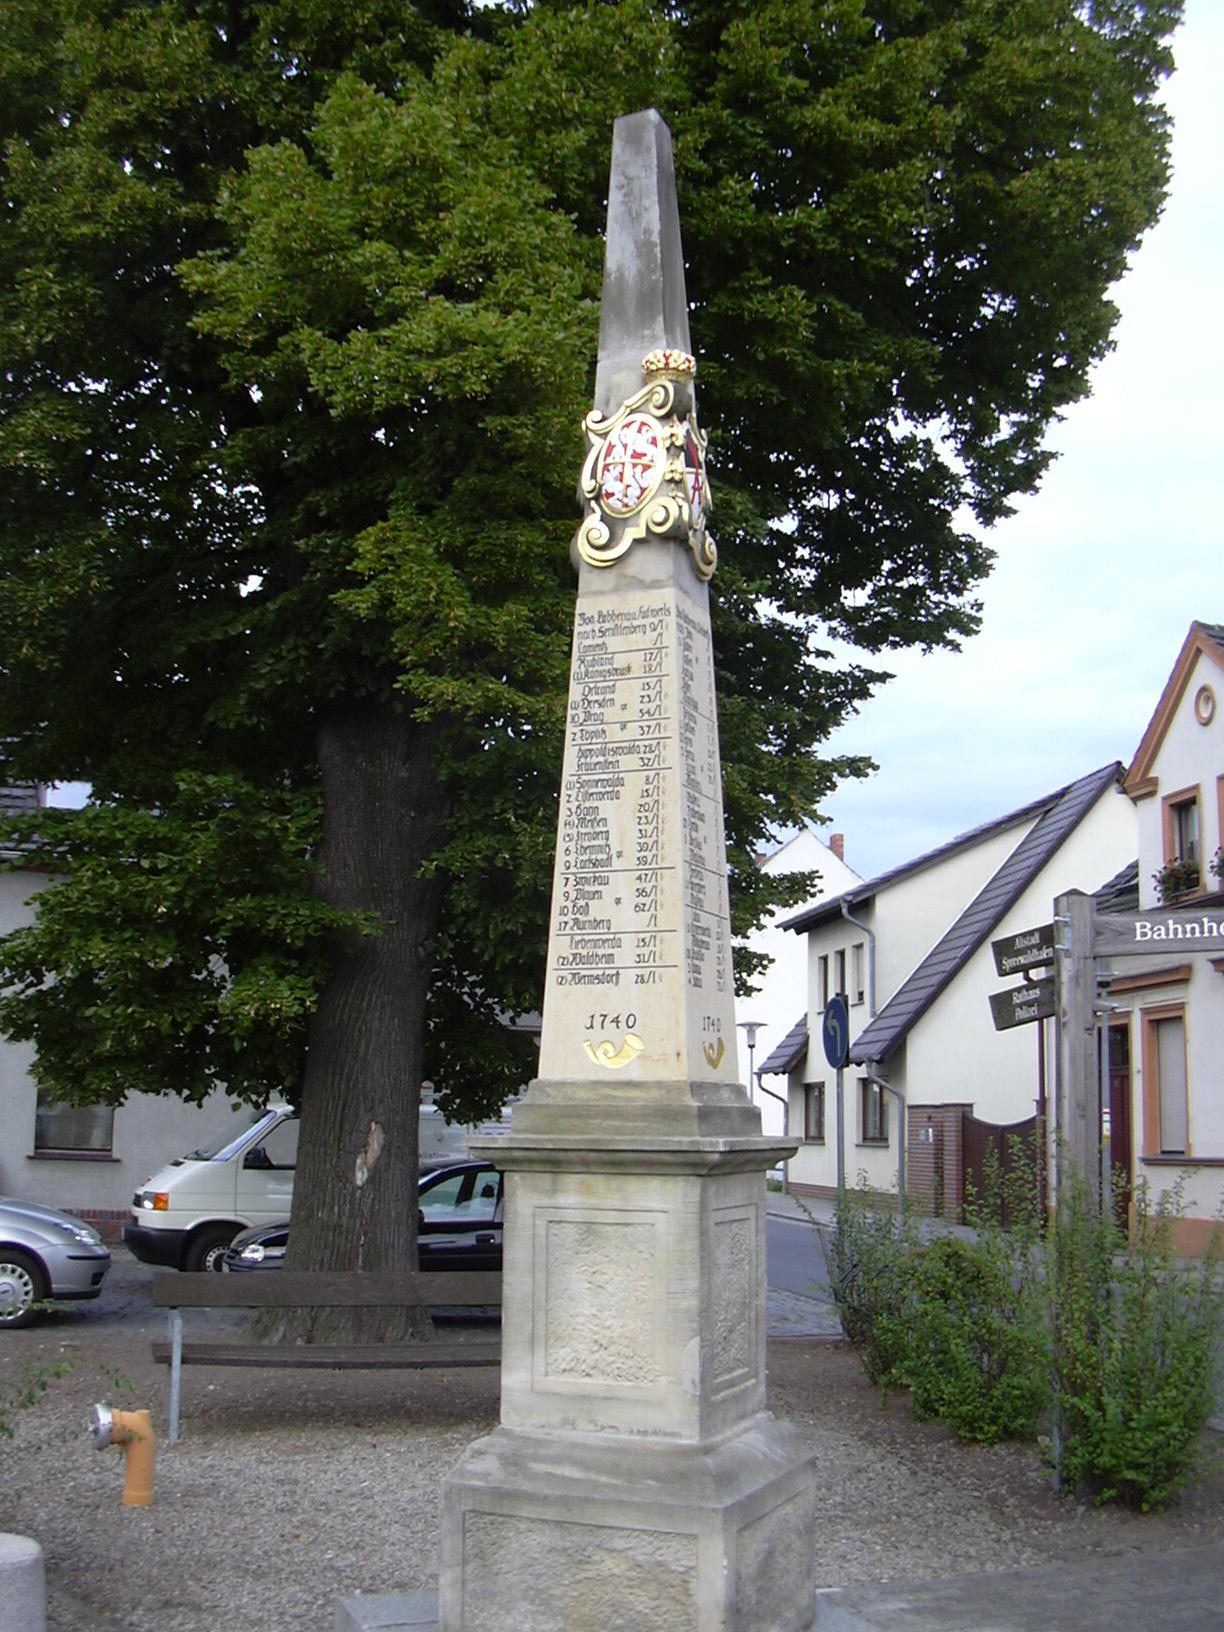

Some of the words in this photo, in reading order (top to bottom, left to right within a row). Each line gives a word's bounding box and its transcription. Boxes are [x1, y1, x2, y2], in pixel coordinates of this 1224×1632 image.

[564, 846, 571, 856] 6
[564, 860, 571, 870] 9
[563, 877, 569, 887] 7
[563, 891, 569, 901] 9
[559, 906, 569, 916] 10
[558, 921, 569, 931] 17
[1014, 932, 1040, 948] Altstadt
[1012, 988, 1040, 1004] Rathaus
[1015, 1004, 1038, 1020] Polizei
[585, 1013, 637, 1030] 1740
[702, 1016, 721, 1032] 1740
